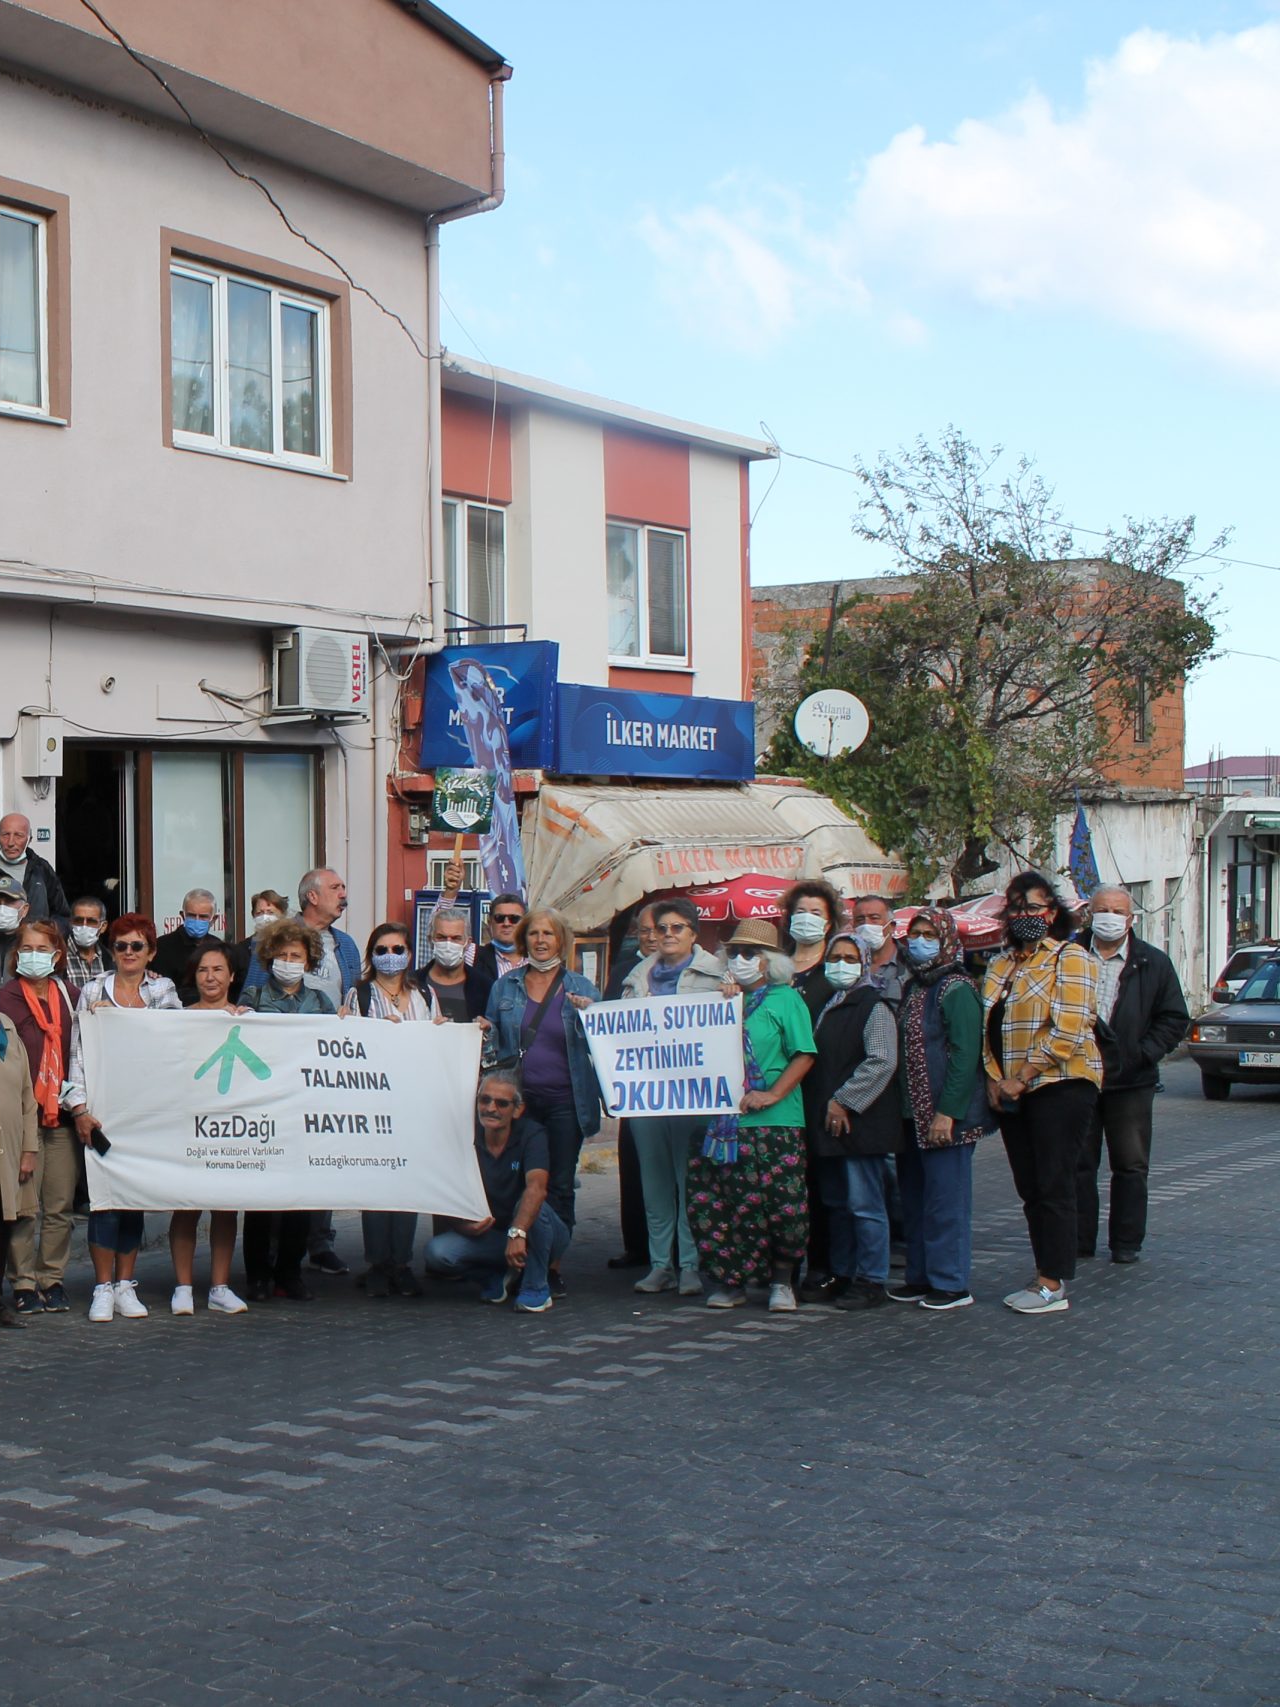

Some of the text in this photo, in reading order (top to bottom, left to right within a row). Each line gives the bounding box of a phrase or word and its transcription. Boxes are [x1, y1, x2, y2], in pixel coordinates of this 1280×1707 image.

[352, 641, 361, 703] VESTEL
[606, 712, 718, 751] İLKER MARKET
[656, 847, 804, 876] İLKER MARKET
[585, 1001, 736, 1035] HAVAMA, SUYUMA
[317, 1036, 367, 1060] DOĞA
[615, 1038, 704, 1072] ZEYTİNİME
[1246, 1053, 1255, 1062] 17
[301, 1068, 391, 1091] TALANINA
[195, 1114, 276, 1143] KazDağı
[304, 1114, 393, 1134] HAYIR !!!
[186, 1147, 208, 1157] Doğal
[220, 1147, 251, 1156] Kültürel
[308, 1155, 408, 1171] kazdagikoruma.org.tr
[206, 1161, 267, 1171] Koruma Derneği
